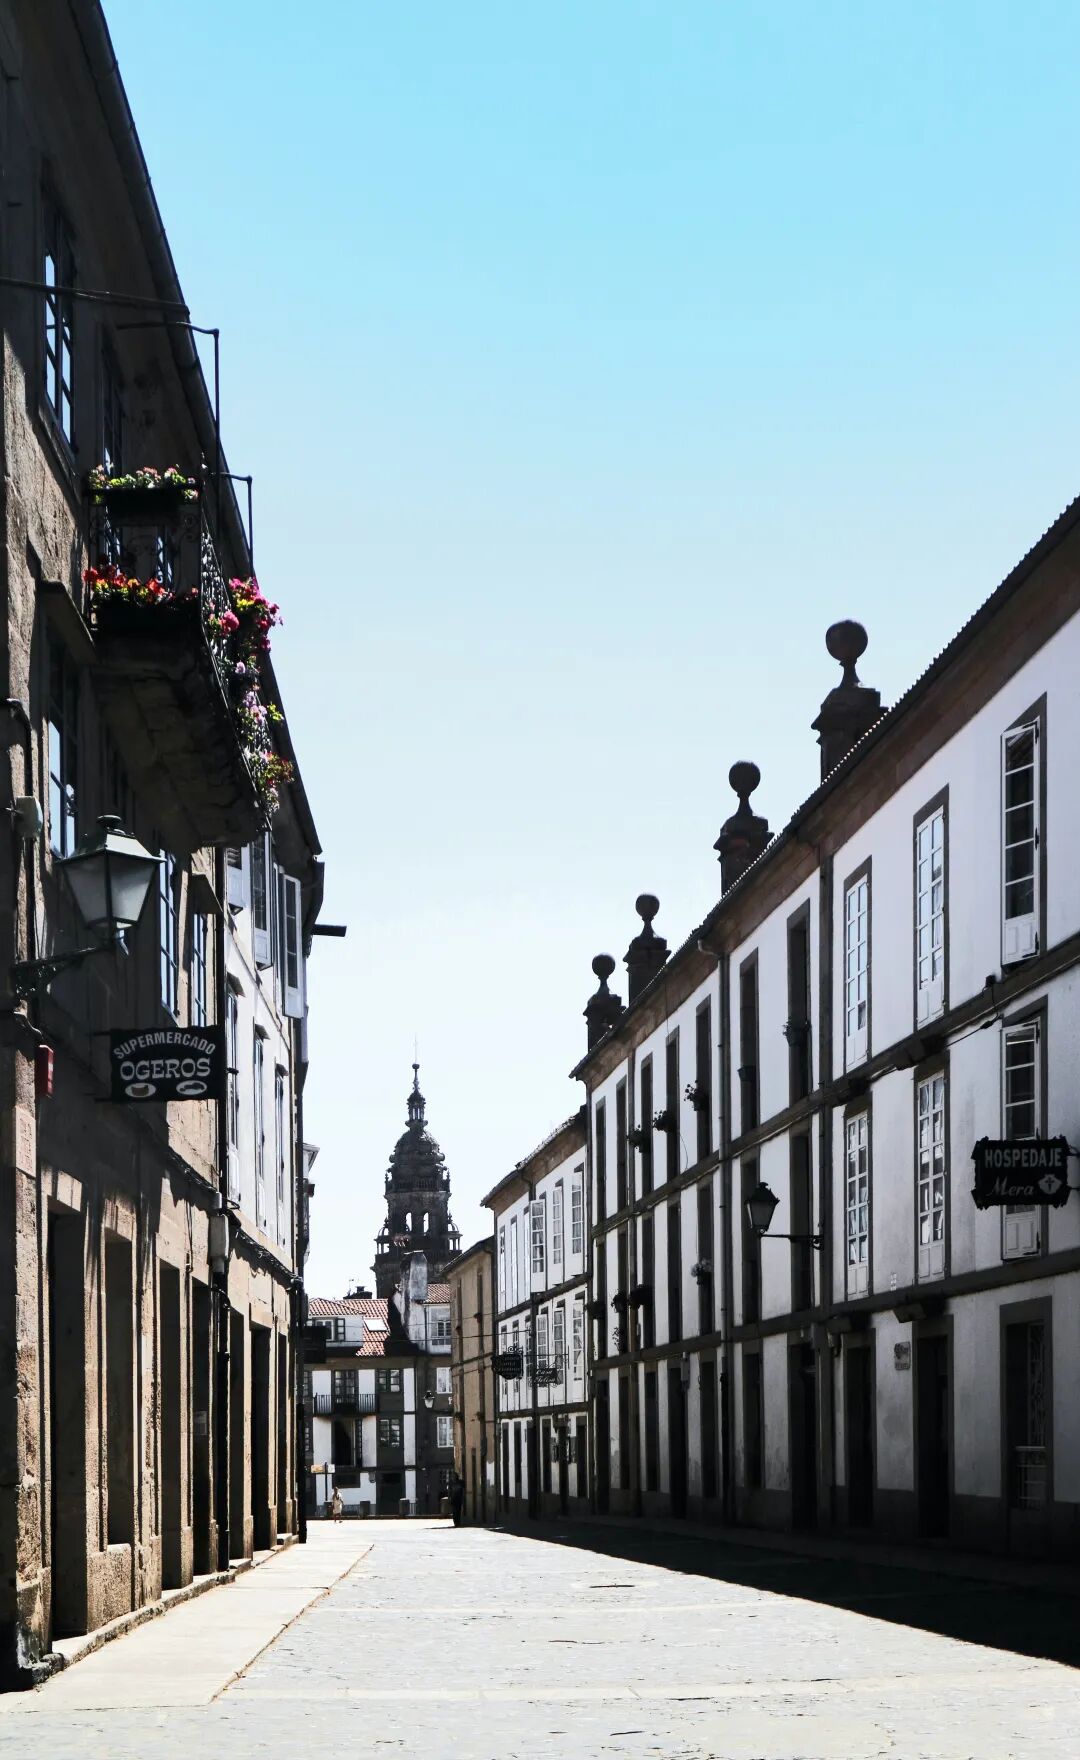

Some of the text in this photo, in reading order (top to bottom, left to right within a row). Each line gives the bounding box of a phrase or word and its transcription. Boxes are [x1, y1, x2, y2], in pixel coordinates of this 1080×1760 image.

[113, 1031, 216, 1059] SUPERMERCADO
[120, 1057, 211, 1080] OGEROS
[984, 1147, 1063, 1168] HOSPEDAJE
[985, 1175, 1034, 1197] Mera
